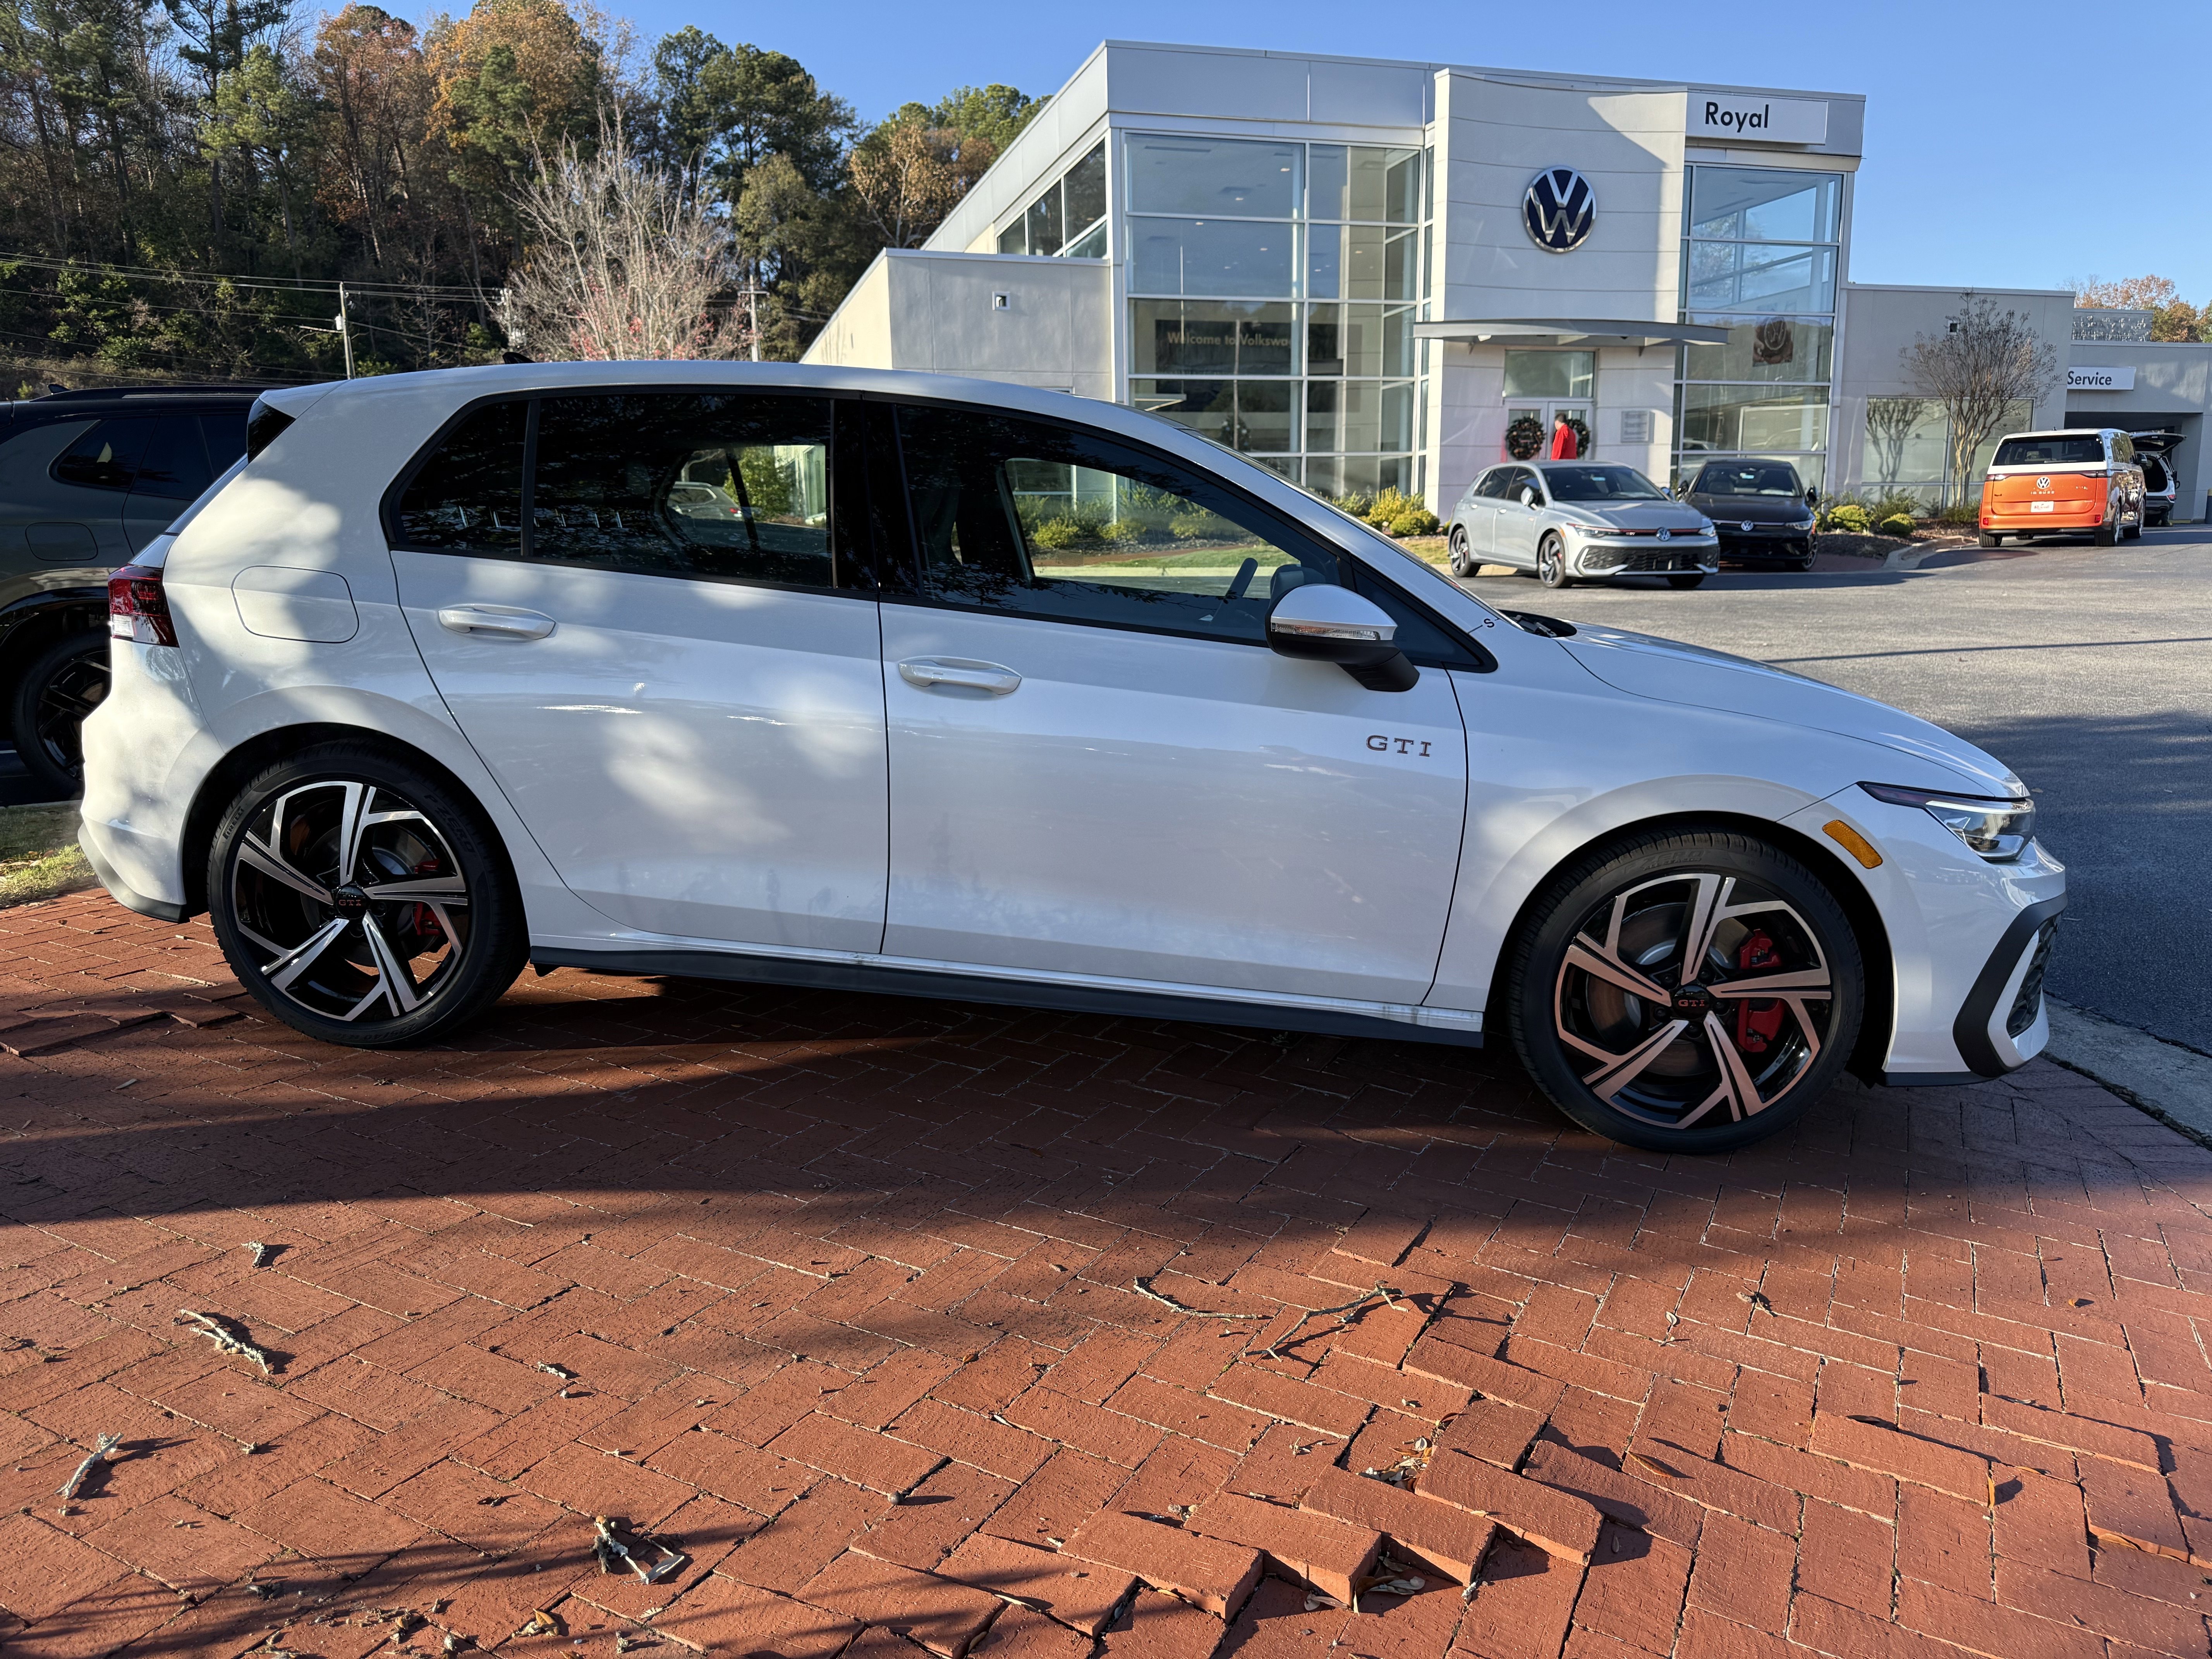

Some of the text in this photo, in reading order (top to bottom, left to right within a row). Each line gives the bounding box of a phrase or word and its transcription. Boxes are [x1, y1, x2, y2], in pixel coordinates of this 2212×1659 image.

[1705, 101, 1769, 132] Royal
[1167, 331, 1310, 346] Wlcome to Volkswa
[2067, 371, 2112, 385] Service
[1484, 618, 1495, 628] S
[1366, 735, 1432, 757] GTI
[222, 805, 244, 840] PIRELLI
